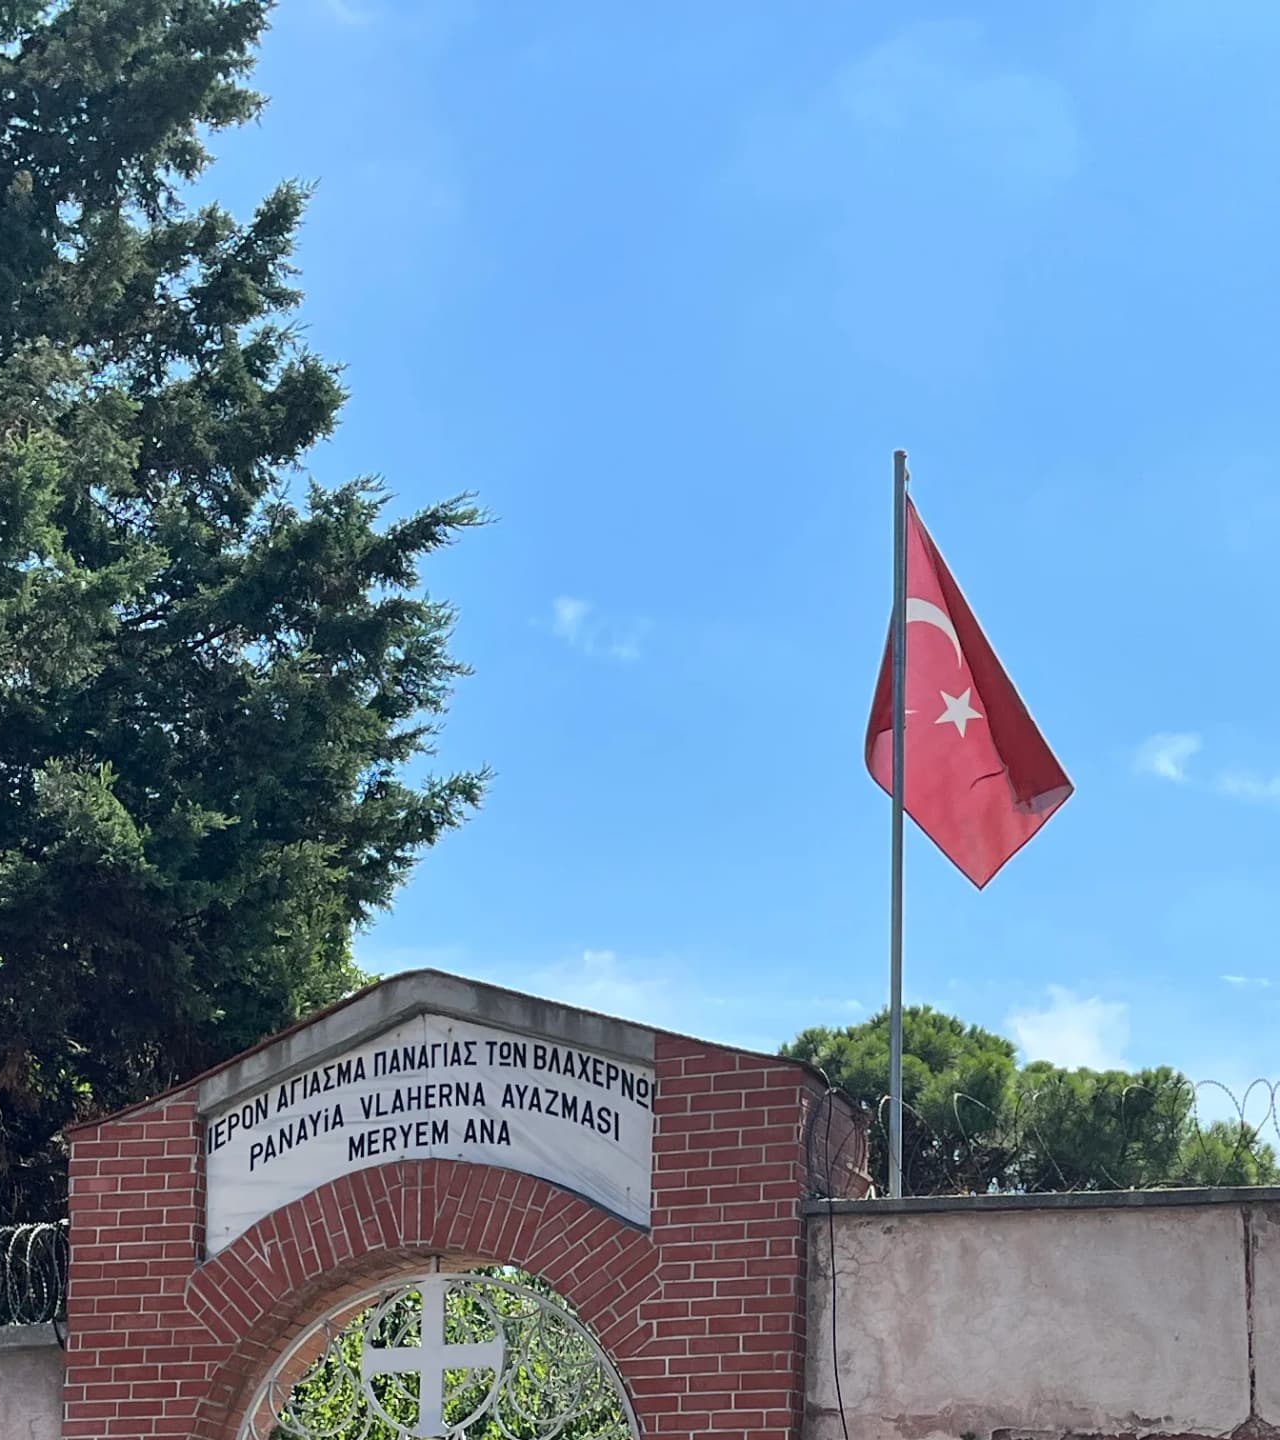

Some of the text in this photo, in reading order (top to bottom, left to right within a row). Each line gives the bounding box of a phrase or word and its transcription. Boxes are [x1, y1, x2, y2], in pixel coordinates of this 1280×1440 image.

[208, 1093, 269, 1155] ΙΕΡΟΝ
[276, 1056, 366, 1113] ΑΓΙΑΣΜΑ
[374, 1041, 478, 1078] ΠΑΝΑΓΙΑΣ
[359, 1081, 486, 1120] VLAHERNA
[501, 1083, 620, 1142] AYAZMASI
[348, 1118, 512, 1162] MERYEM ANA
